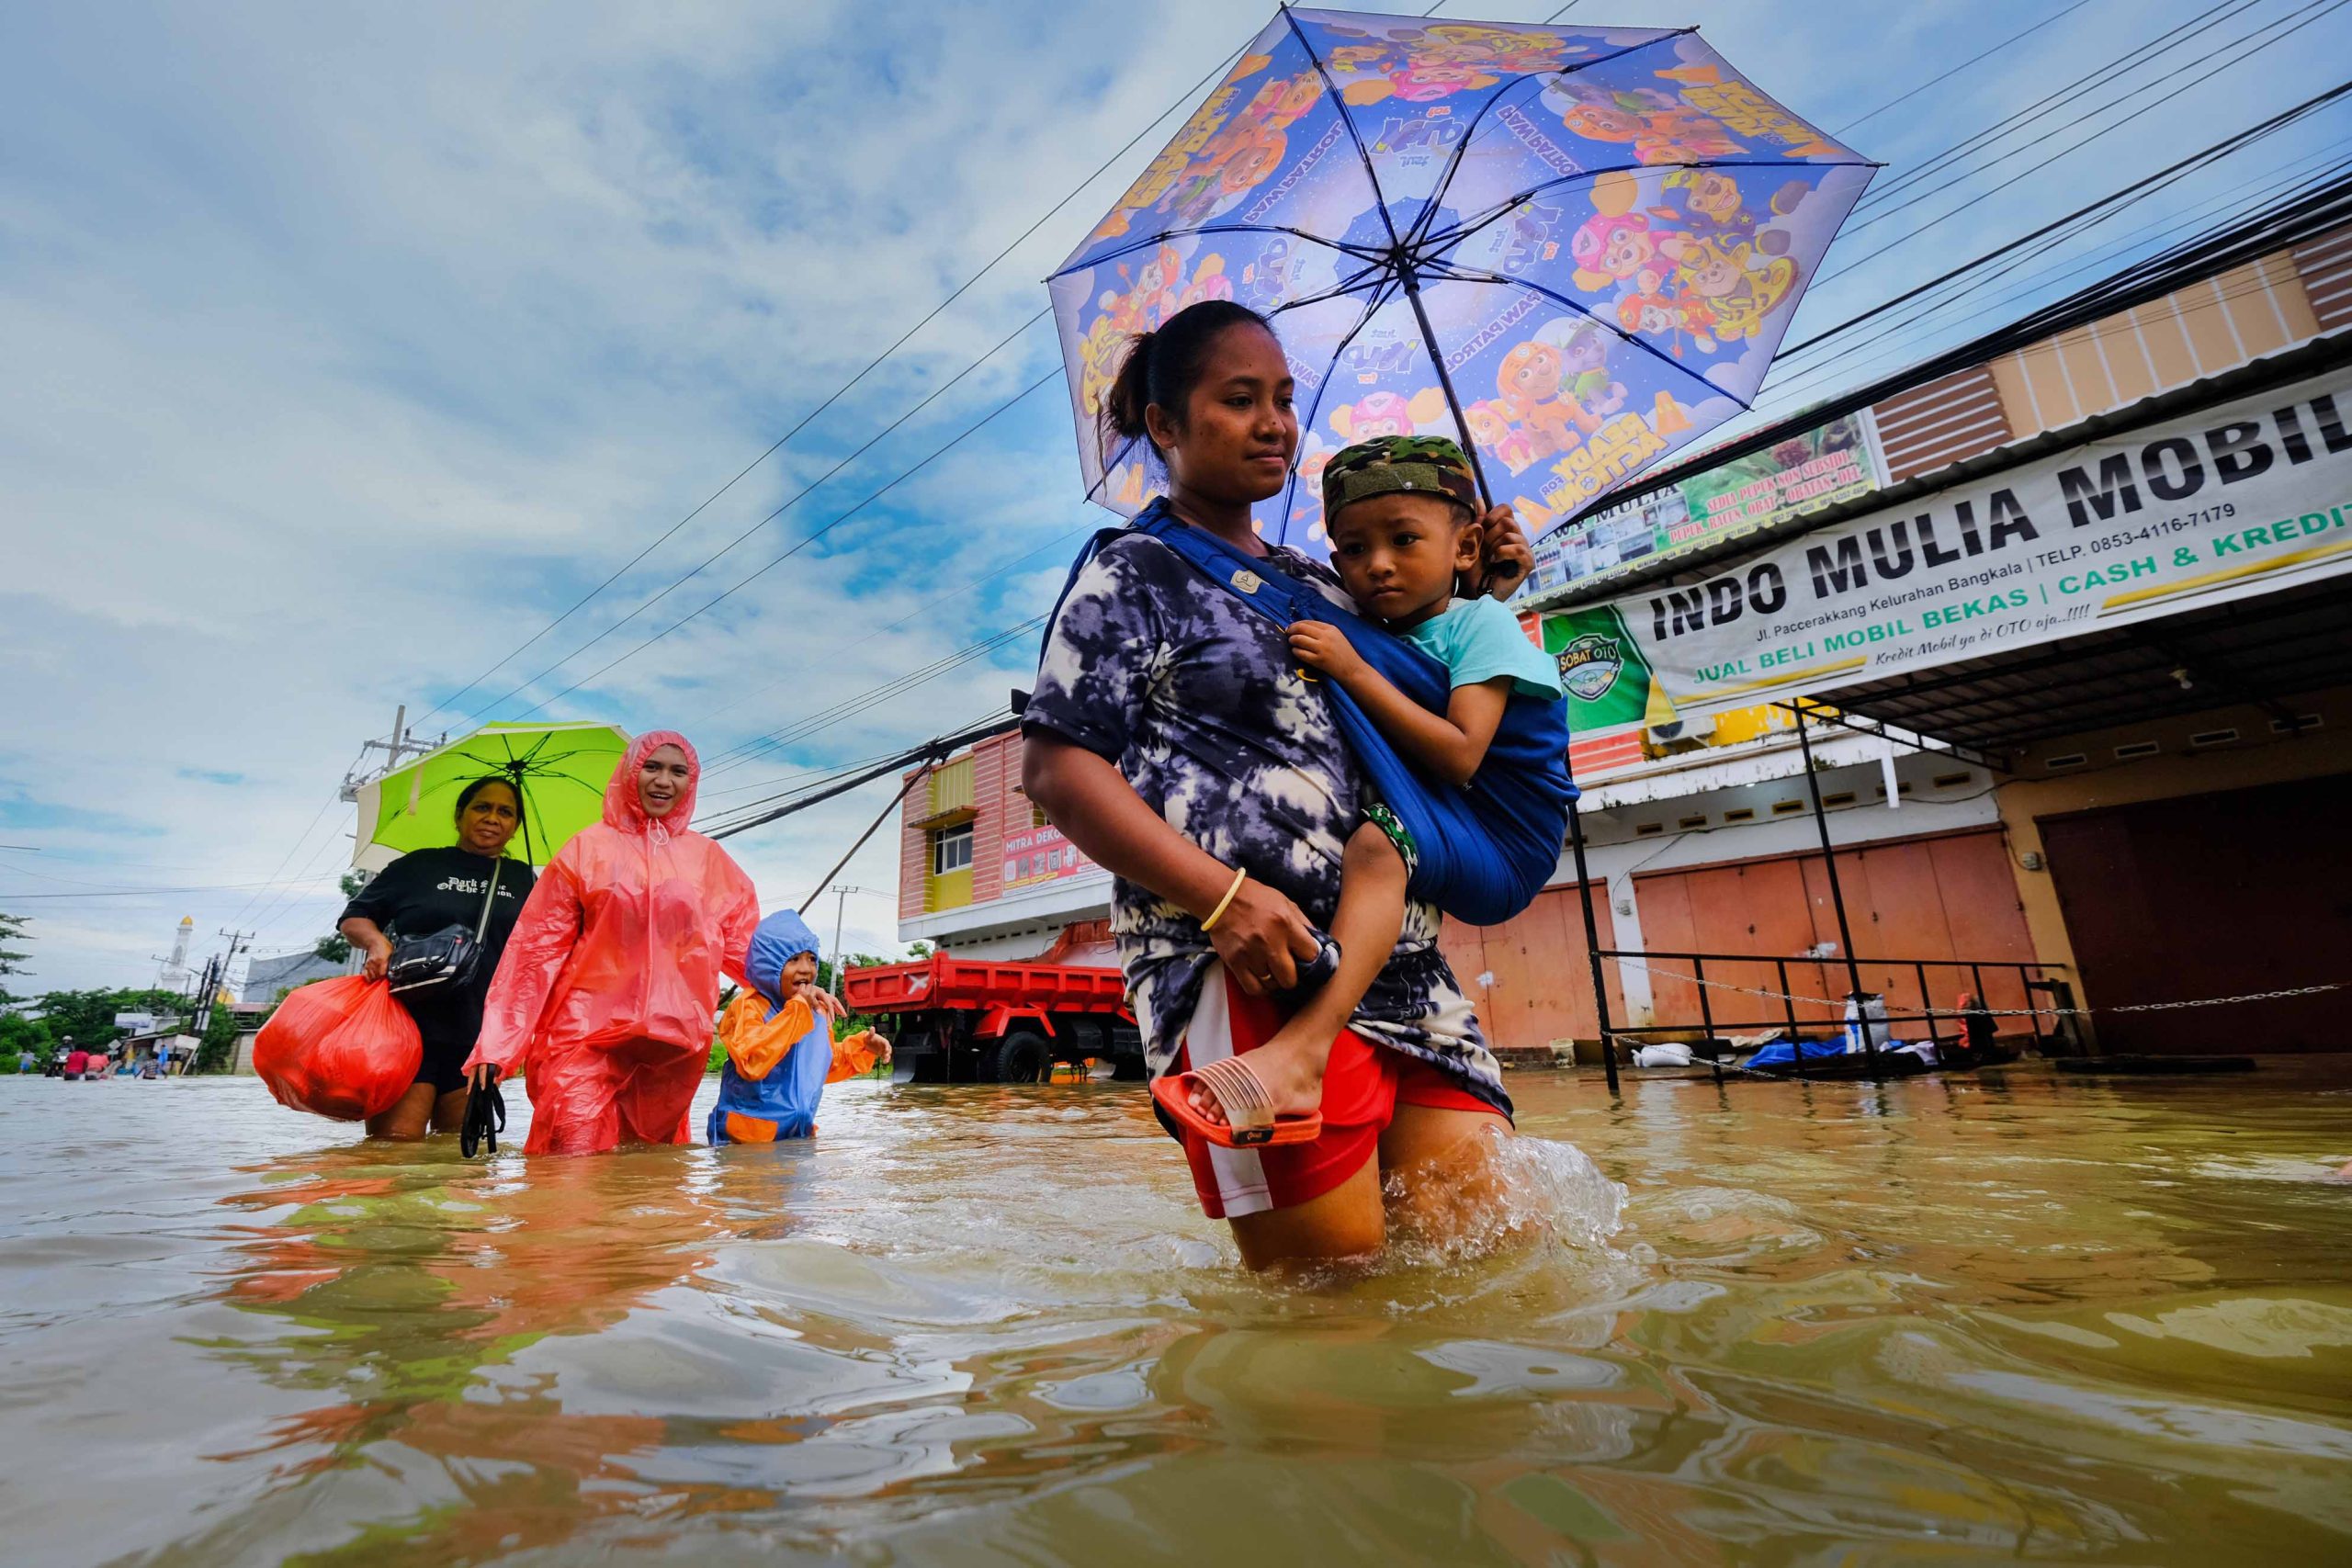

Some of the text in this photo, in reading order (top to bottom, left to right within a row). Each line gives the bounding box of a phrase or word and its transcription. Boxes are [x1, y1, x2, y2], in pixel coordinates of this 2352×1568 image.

[1707, 492, 1738, 513] SEDIA
[1739, 478, 1776, 501] PUPUK
[1778, 469, 1802, 488] NON
[1747, 497, 1776, 515] OBAT
[1649, 394, 2352, 641] INDO MULIA MOBIL
[1757, 629, 1771, 642] Jl.
[1774, 604, 1866, 637] Paccerakkang
[1870, 584, 1943, 612] Kelurahan
[1948, 562, 2023, 591] Bangkala
[2036, 546, 2086, 568] TELP.
[2091, 503, 2235, 554] 0853-4116-7179
[1693, 660, 1752, 684] JUAL
[1758, 641, 1815, 669] BELI
[1824, 619, 1914, 653] MOBIL
[1922, 589, 2030, 629] BEKAS
[2058, 556, 2157, 594] CASH
[2173, 547, 2199, 567] &
[1560, 645, 1616, 671] SOBAT OTO
[1876, 649, 1913, 665] Kredit
[1917, 636, 1956, 656] Mobil
[1959, 636, 1975, 650] ya
[1980, 626, 1993, 640] di
[1996, 619, 2032, 637] OTO
[1006, 836, 1034, 852] MITRA
[448, 876, 478, 887] Dark
[456, 884, 479, 894] The
